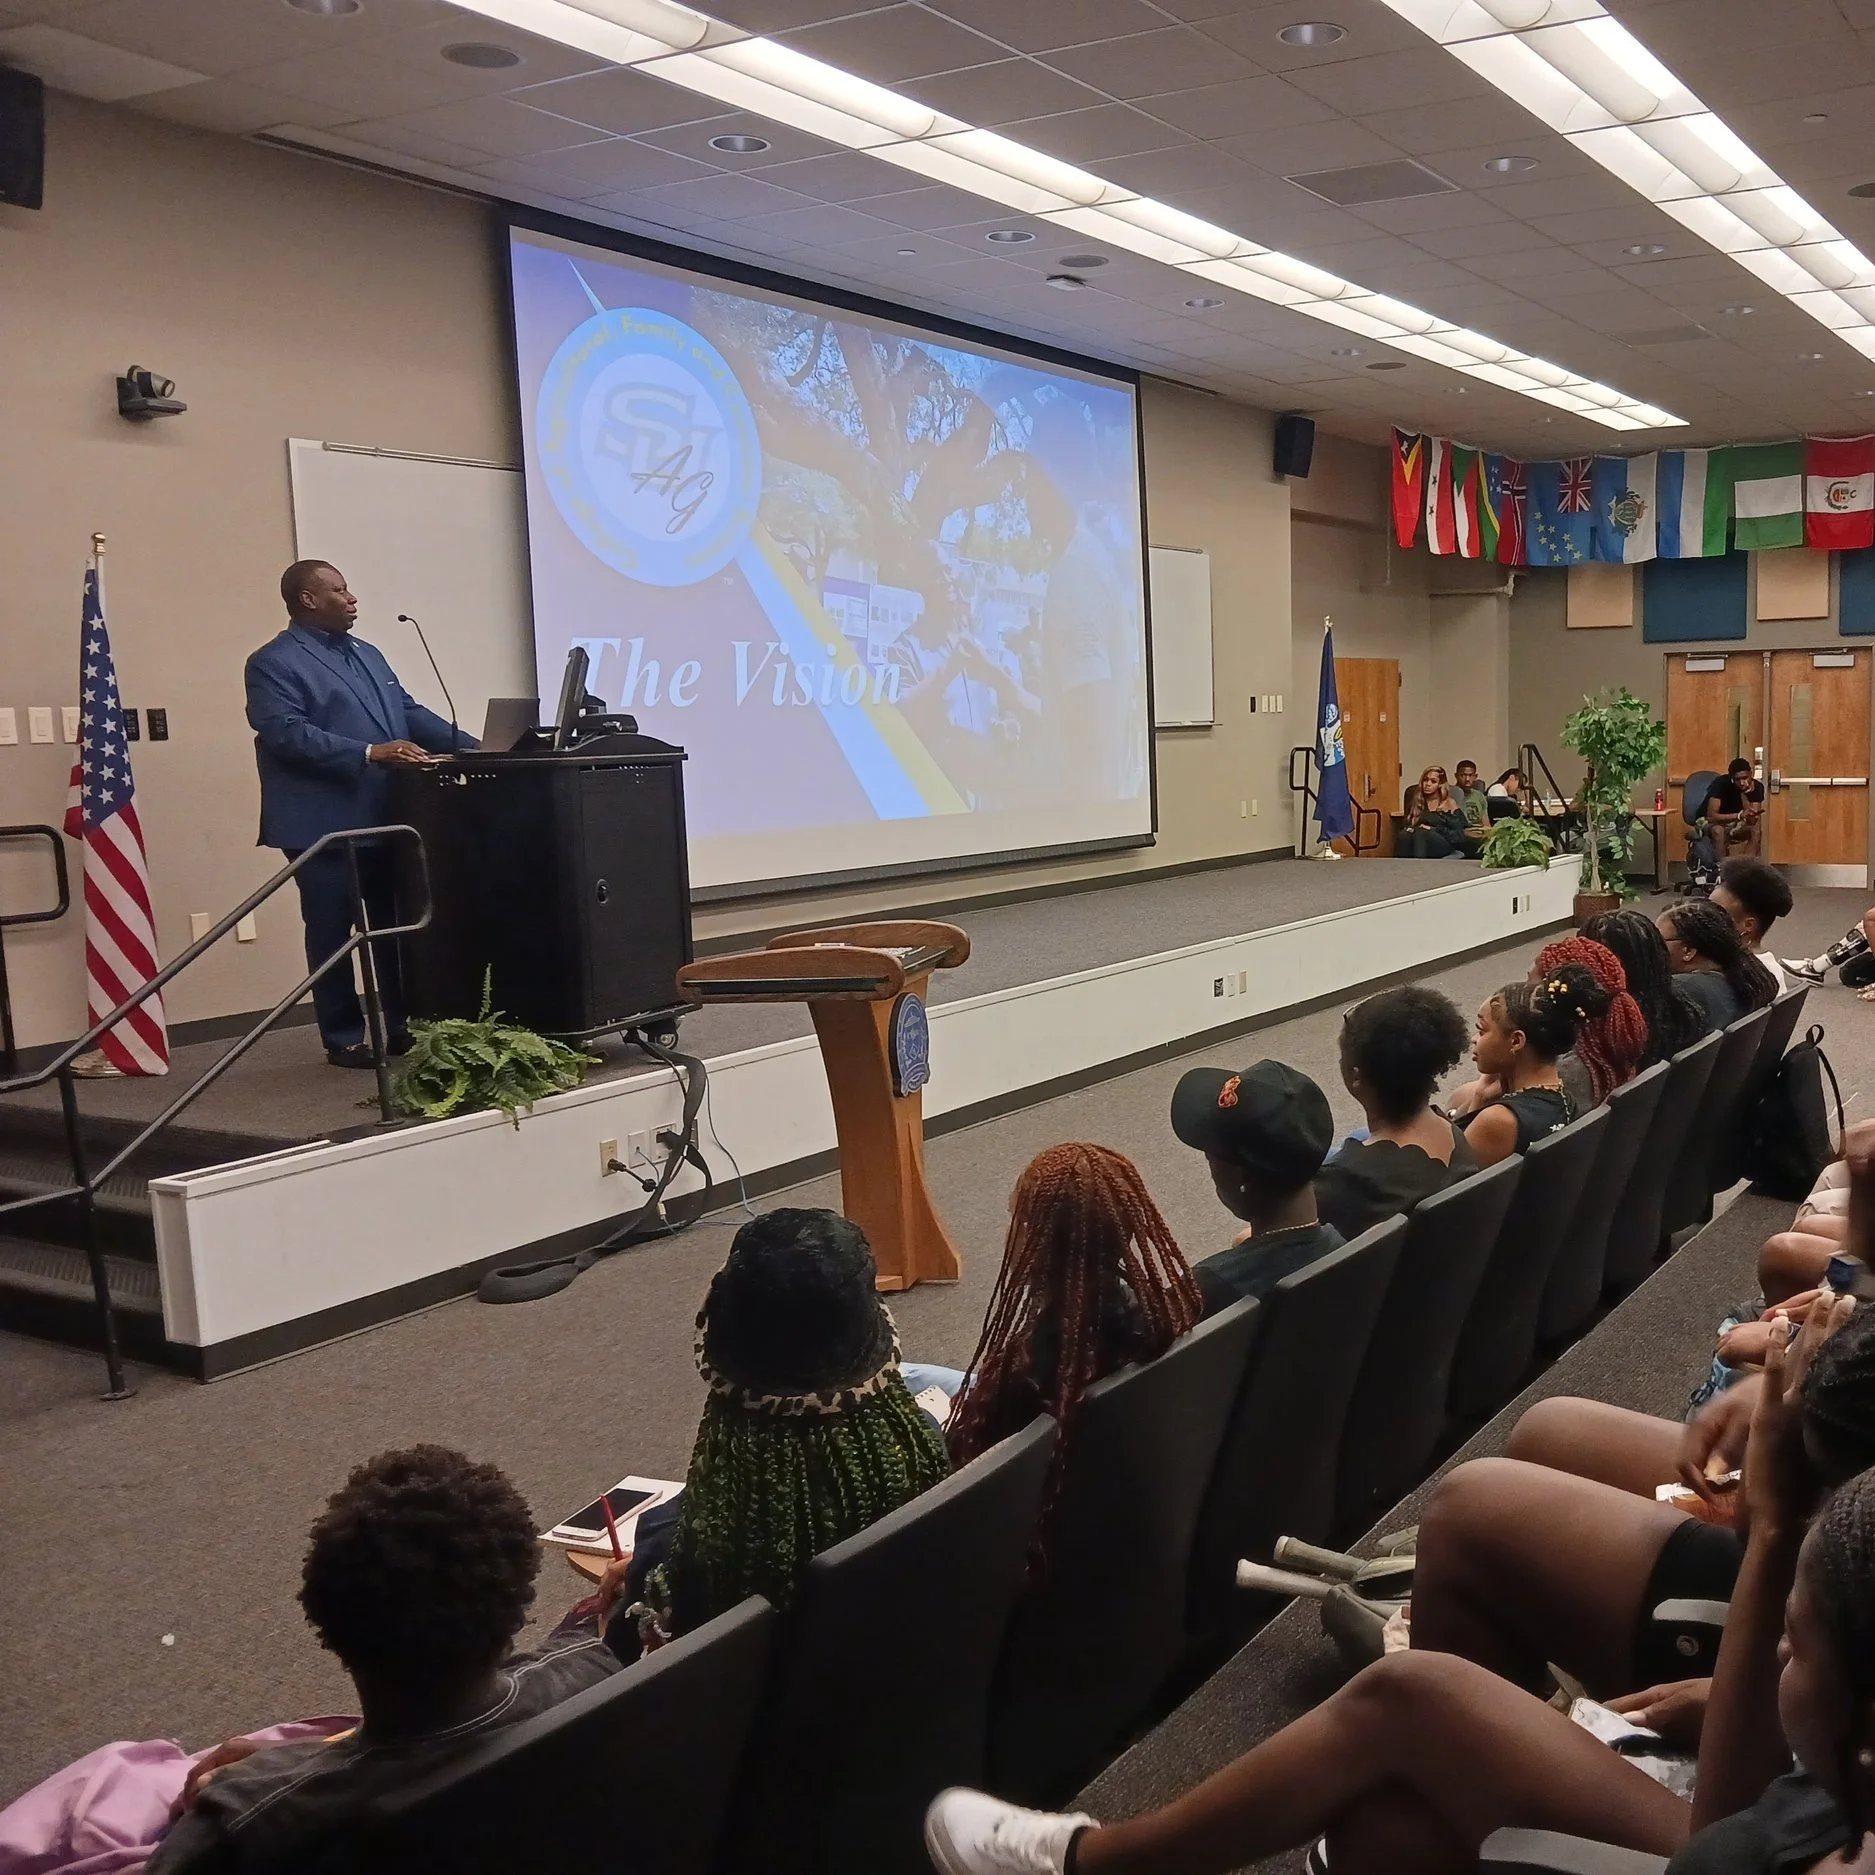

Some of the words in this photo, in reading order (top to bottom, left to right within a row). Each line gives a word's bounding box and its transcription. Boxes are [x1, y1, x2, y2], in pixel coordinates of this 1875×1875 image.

[619, 313, 687, 351] Family
[569, 636, 702, 708] The
[730, 639, 903, 708] Vision
